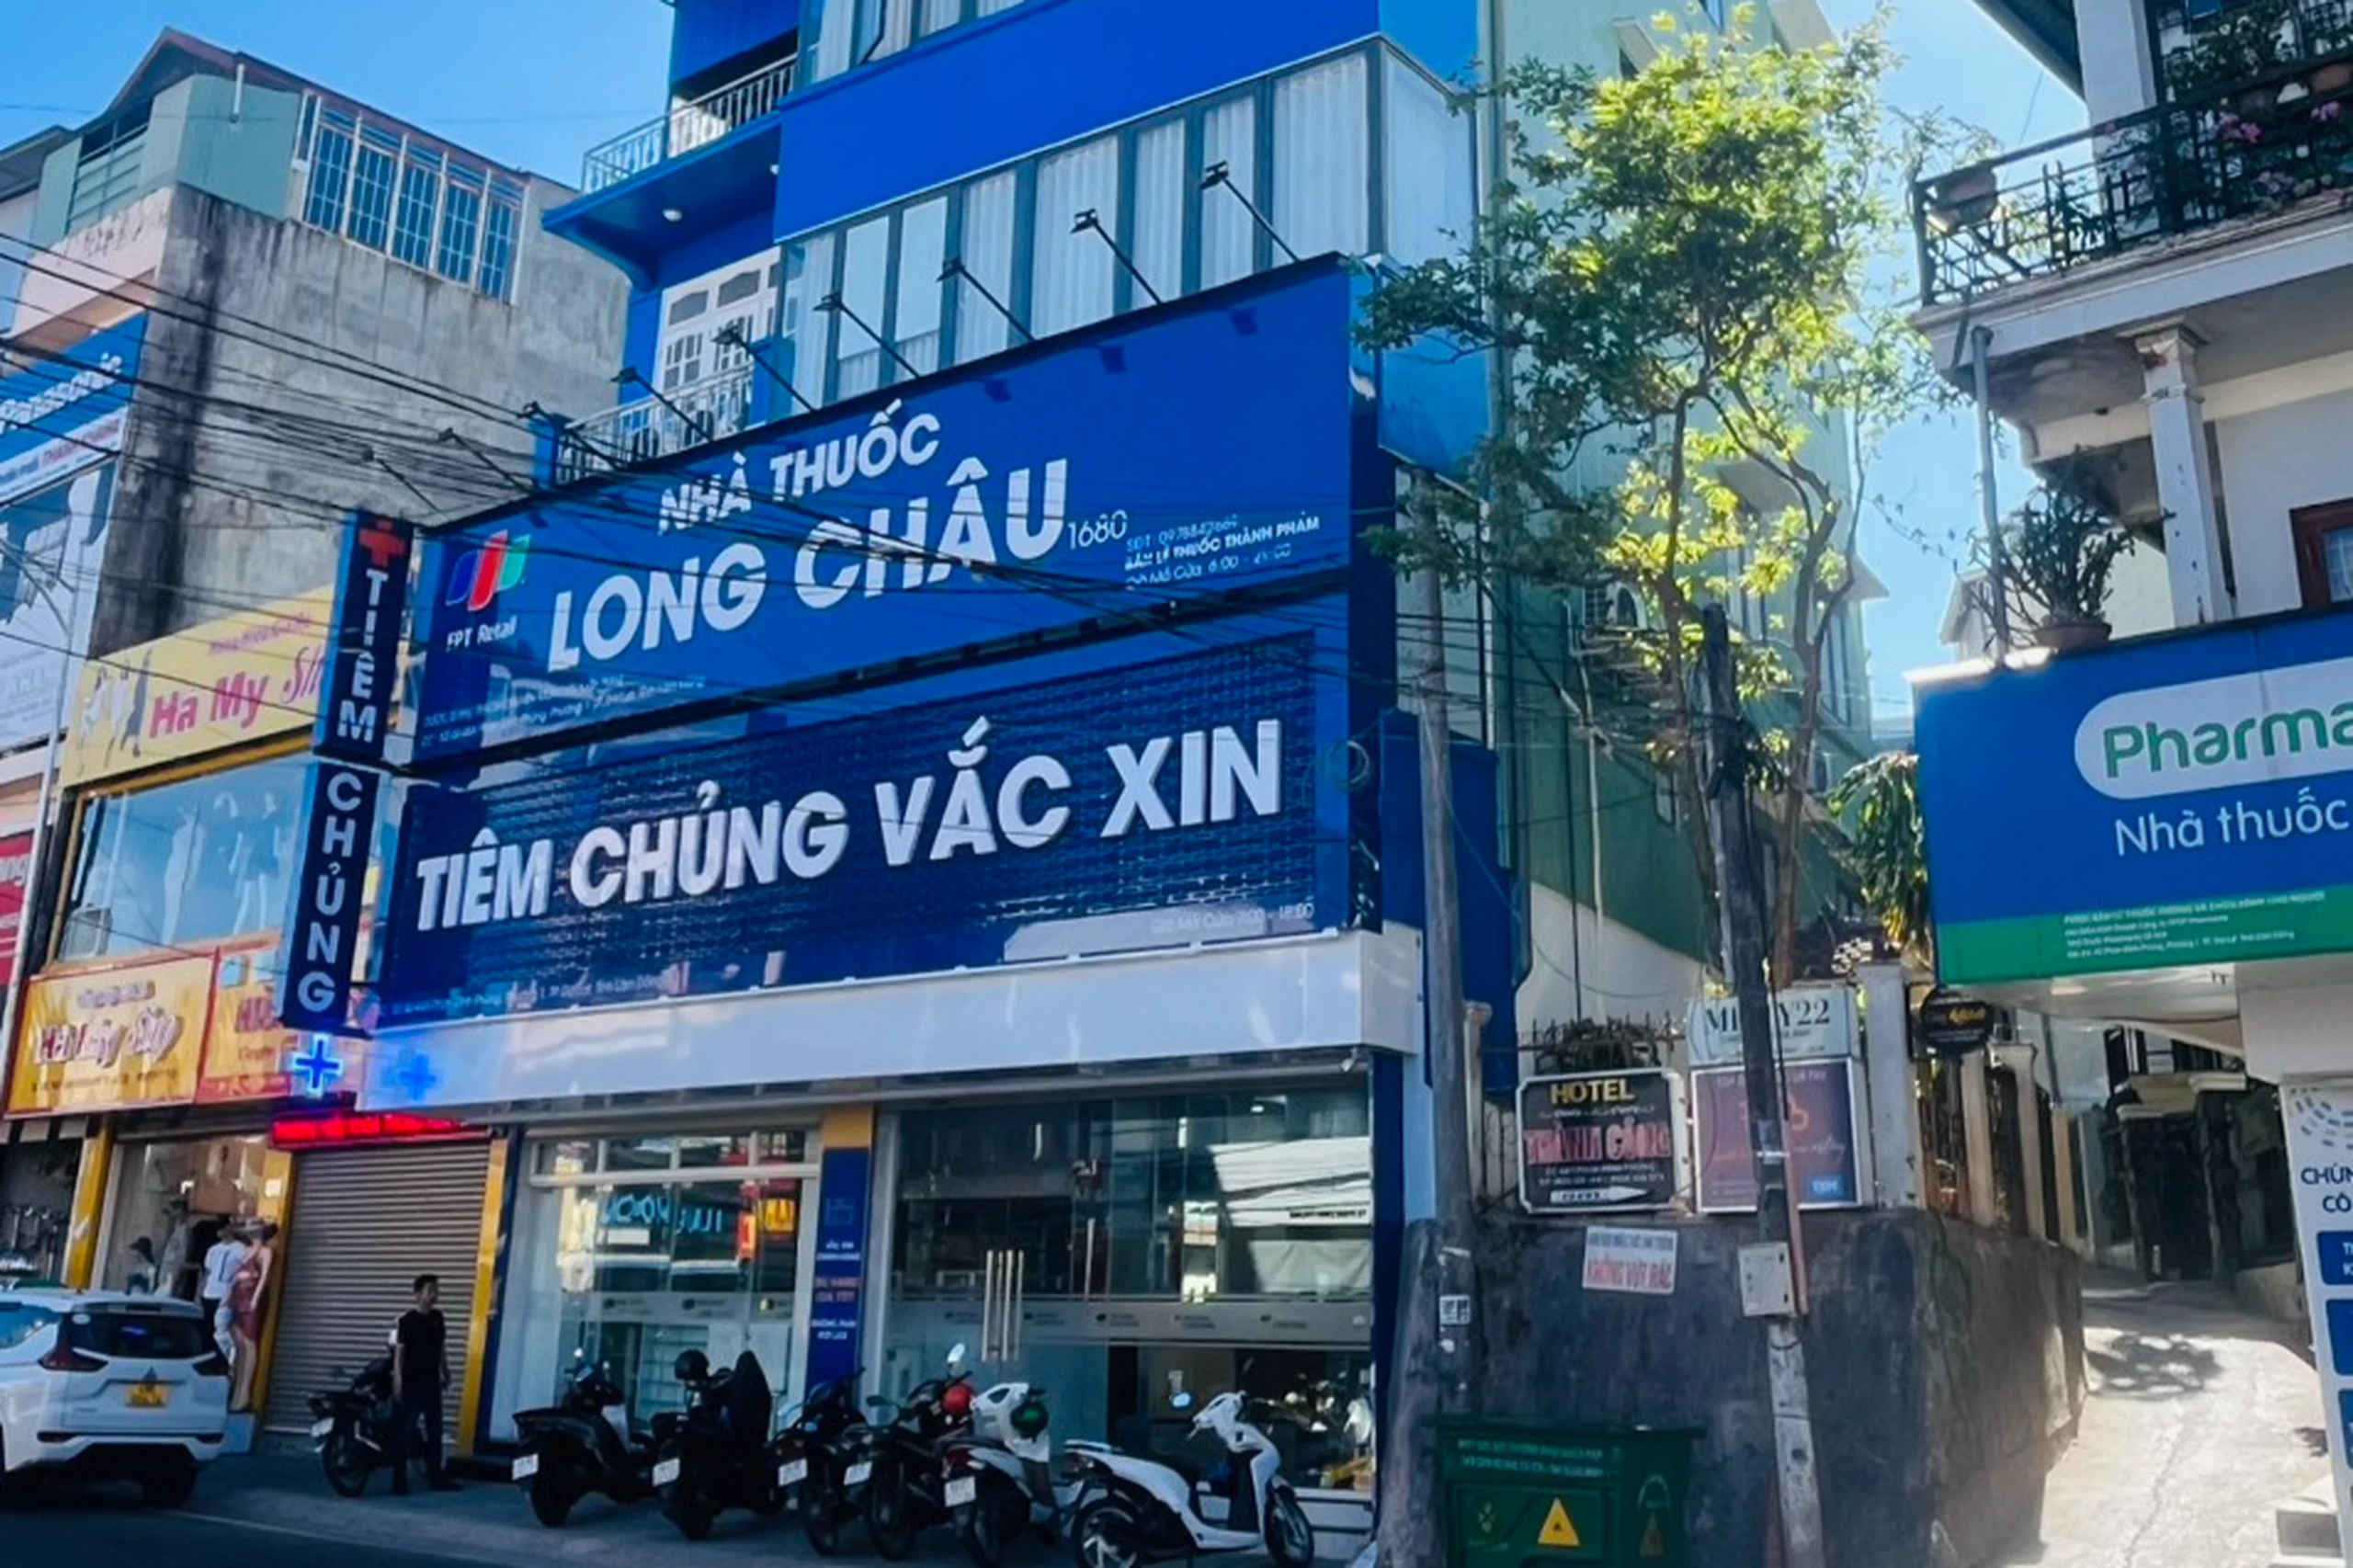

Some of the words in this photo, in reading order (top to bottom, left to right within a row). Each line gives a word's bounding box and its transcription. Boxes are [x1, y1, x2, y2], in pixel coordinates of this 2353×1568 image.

[657, 452, 752, 535] NHÀ
[769, 398, 940, 501] THUỐC
[549, 542, 767, 672] LONG
[794, 456, 1067, 608] CHÂU
[1068, 509, 1128, 549] 1680
[150, 691, 199, 738] Ha
[210, 671, 269, 729] My
[417, 828, 551, 931] TIÊM
[570, 779, 849, 909] CHỦNG
[875, 715, 1072, 867] VẮC
[1101, 718, 1282, 837] XIN
[2114, 809, 2204, 856] Nhà
[2217, 786, 2349, 844] thuốc
[298, 772, 362, 1013] CHỦNG
[1550, 1078, 1635, 1104] HOTEL
